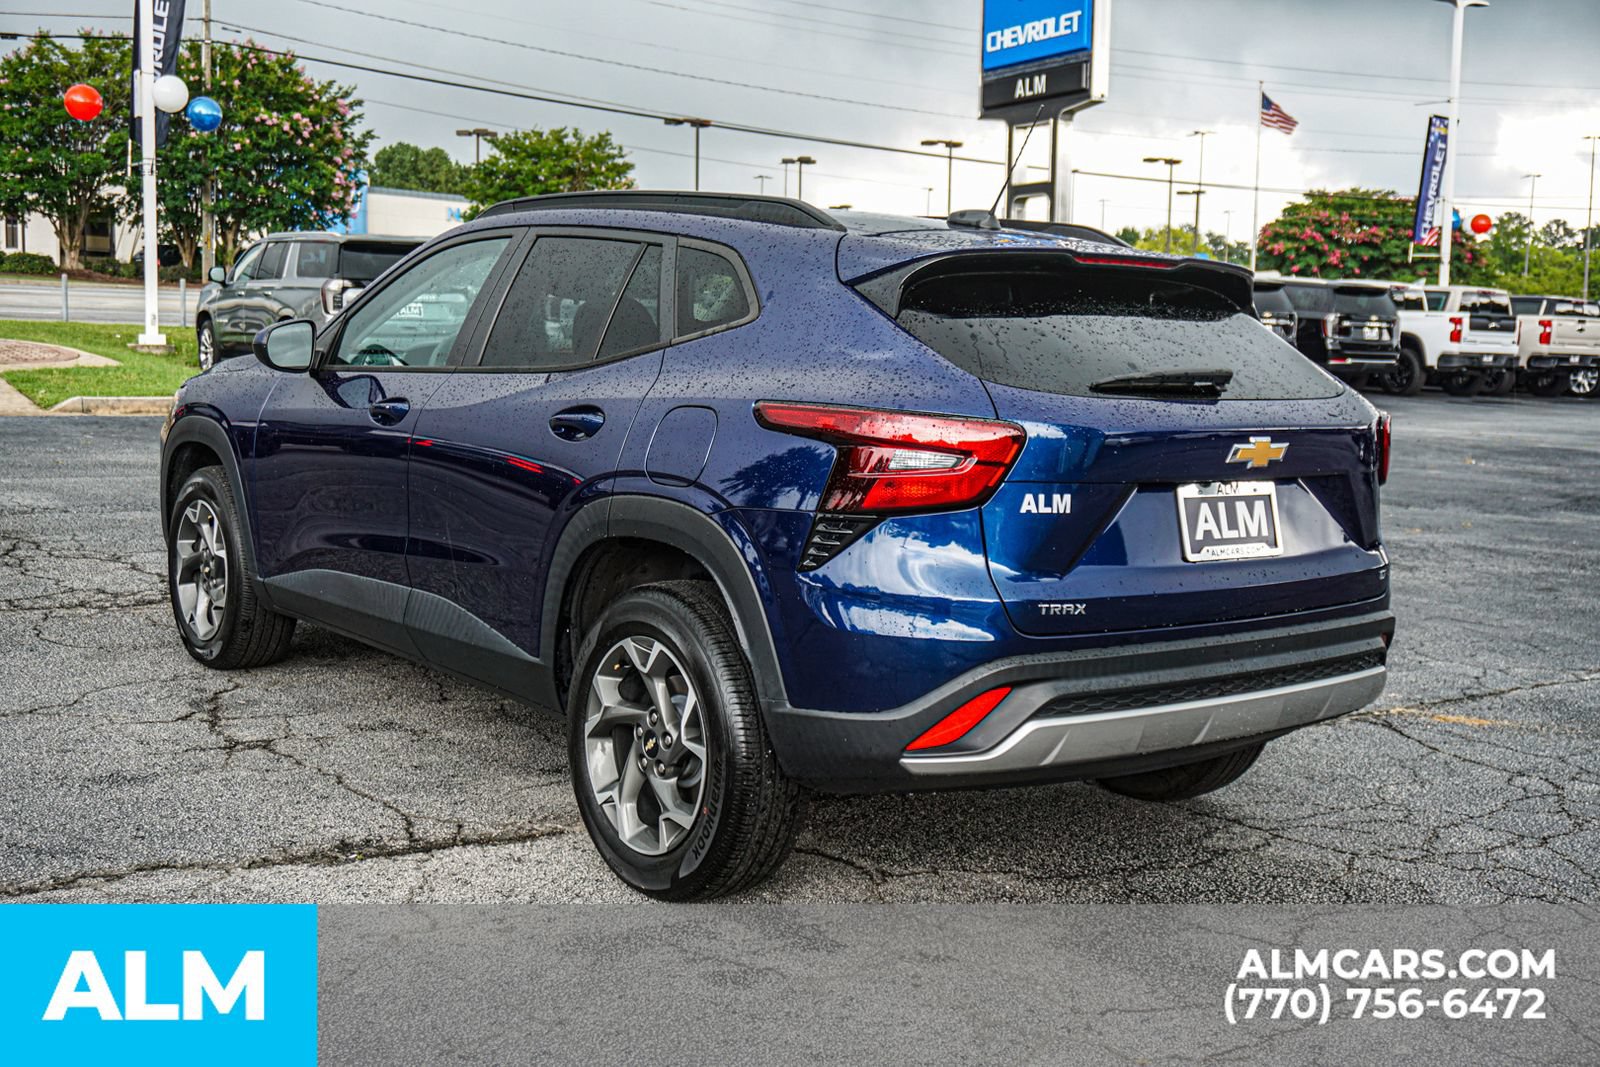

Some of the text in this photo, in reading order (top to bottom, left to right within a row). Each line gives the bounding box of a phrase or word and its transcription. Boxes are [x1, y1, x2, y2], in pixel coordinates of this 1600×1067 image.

[986, 9, 1082, 52] CHEVROLET
[1014, 74, 1047, 98] ALM
[1020, 493, 1071, 514] ALM
[1195, 501, 1268, 540] ALM
[1038, 603, 1087, 616] TRAX
